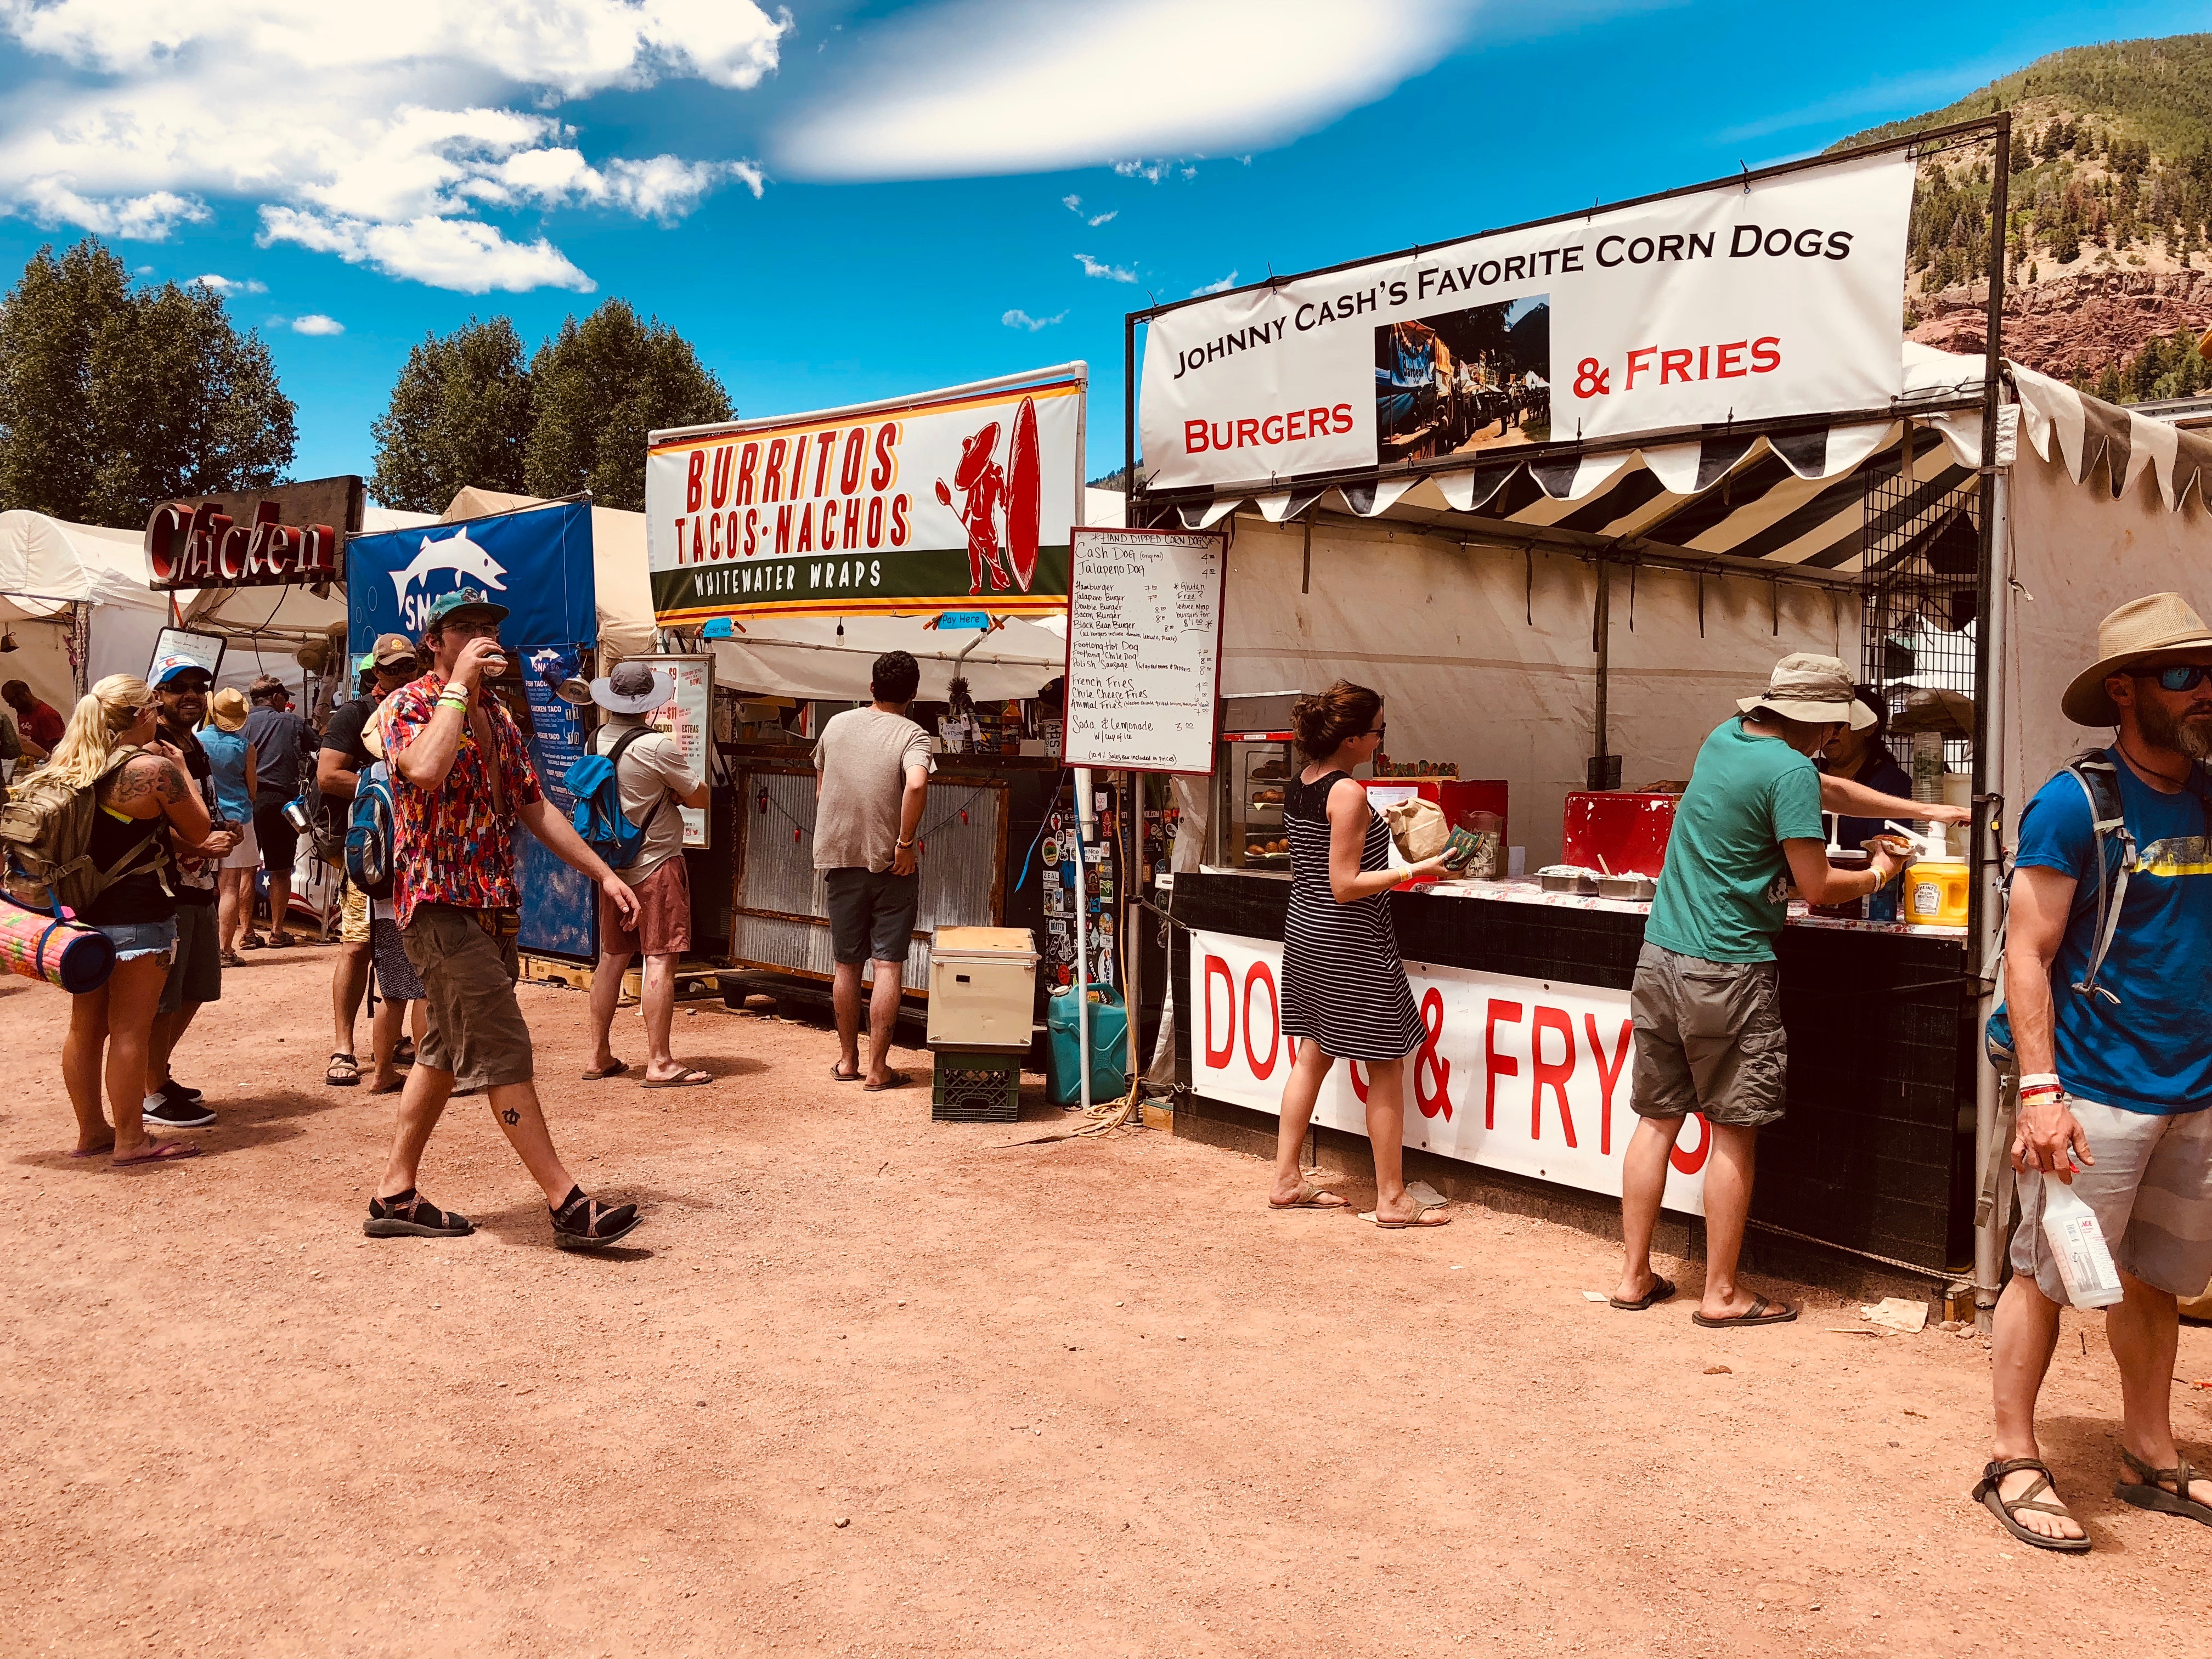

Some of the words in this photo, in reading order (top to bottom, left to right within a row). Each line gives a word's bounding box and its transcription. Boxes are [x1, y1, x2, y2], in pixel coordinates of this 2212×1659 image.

[1572, 357, 1610, 399] &
[686, 421, 904, 514] BURRITOS
[144, 500, 335, 584] Chicken
[1130, 534, 1161, 544] DIPPED
[1164, 534, 1185, 545] CORN
[1075, 541, 1108, 559] Cash
[1076, 560, 1124, 577] Jalapeno
[694, 563, 794, 598] WHITEWATER
[809, 559, 881, 590] WRAPS
[1075, 580, 1115, 594] Hamburger
[1074, 591, 1103, 602] Jalapeno
[1105, 592, 1125, 606] Burger
[1074, 601, 1097, 611] Double
[1099, 603, 1124, 613] Burger
[943, 614, 956, 625] Pay
[960, 614, 980, 624] Here
[1074, 610, 1095, 620] Bacon
[1096, 611, 1122, 623] Burger
[706, 626, 720, 635] Order
[1073, 619, 1094, 630] Black
[1096, 620, 1111, 629] Bean
[1112, 620, 1136, 633] Burger
[1091, 630, 1108, 639] burgers
[1073, 640, 1104, 656] Footlong
[1104, 639, 1119, 651] Hot
[1121, 641, 1139, 657] Dog
[1071, 657, 1096, 670] Polish
[1100, 659, 1129, 673] Sausage
[1072, 649, 1101, 663] Footlong
[1105, 651, 1122, 659] Chile
[1124, 652, 1138, 667] Dog
[1070, 672, 1103, 688] French
[1106, 675, 1135, 691] Fries
[1072, 686, 1094, 698] Chile
[1097, 687, 1124, 703] Cheese
[1125, 689, 1148, 699] Fries
[1070, 698, 1098, 711] Animal
[1099, 699, 1123, 709] Fries
[682, 724, 699, 733] EXTRAS
[1072, 715, 1096, 734] Soda
